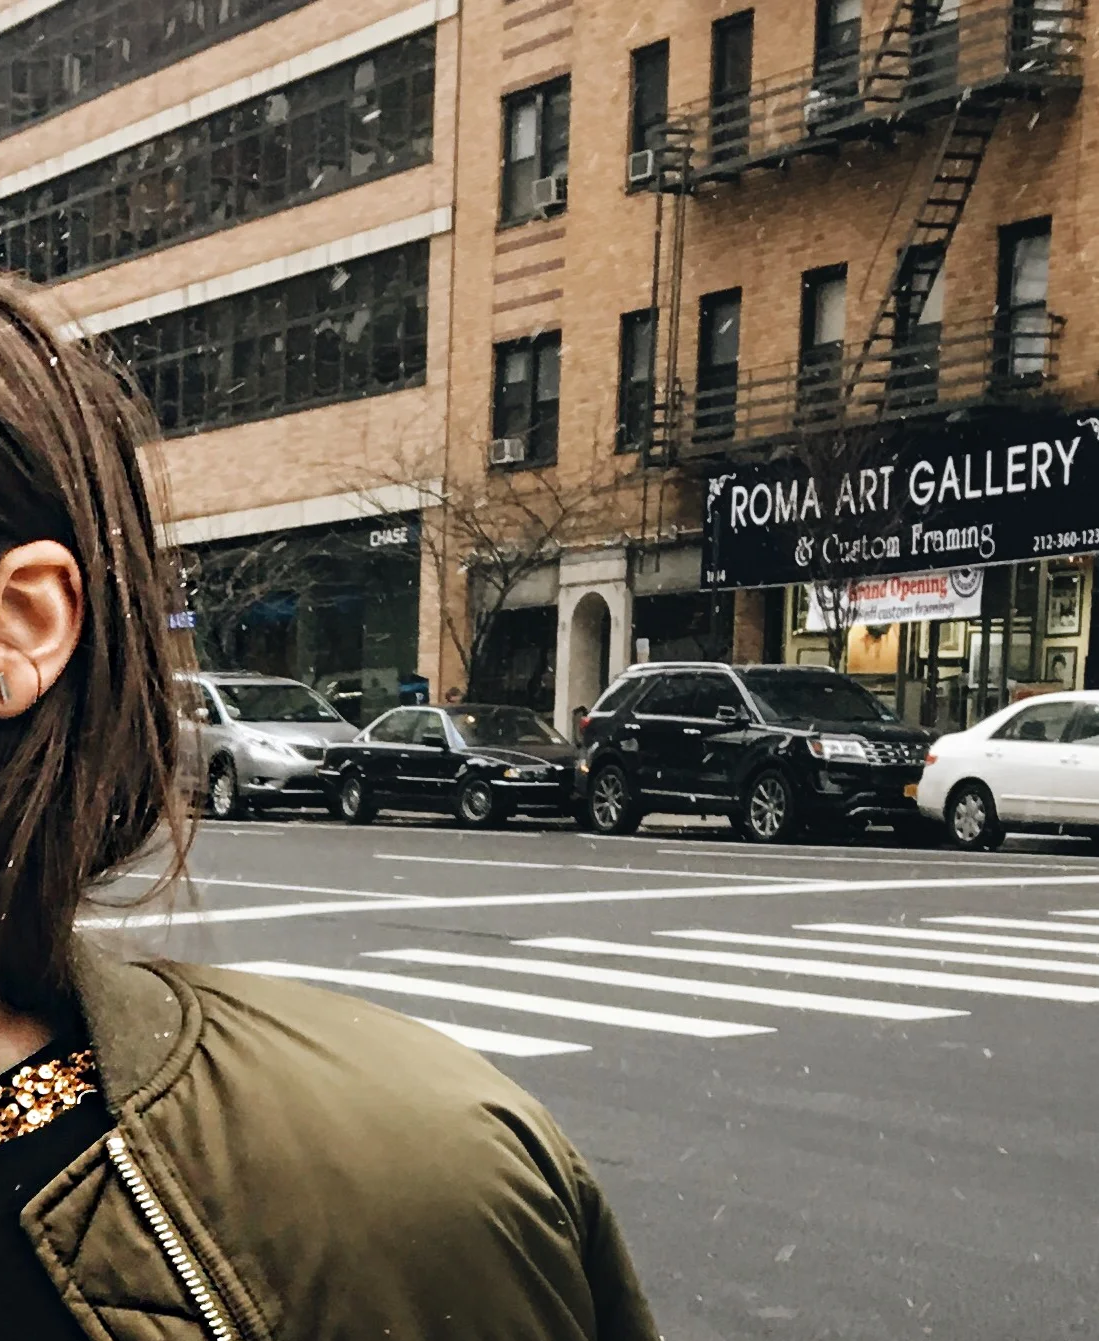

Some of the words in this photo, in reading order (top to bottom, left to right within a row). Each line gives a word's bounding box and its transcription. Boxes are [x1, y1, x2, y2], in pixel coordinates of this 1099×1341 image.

[730, 476, 821, 527] ROMA
[834, 465, 895, 516] ART
[909, 436, 1081, 506] GALLERY
[370, 526, 408, 547] CHASE
[910, 522, 996, 559] Framing
[890, 574, 948, 601] Opening
